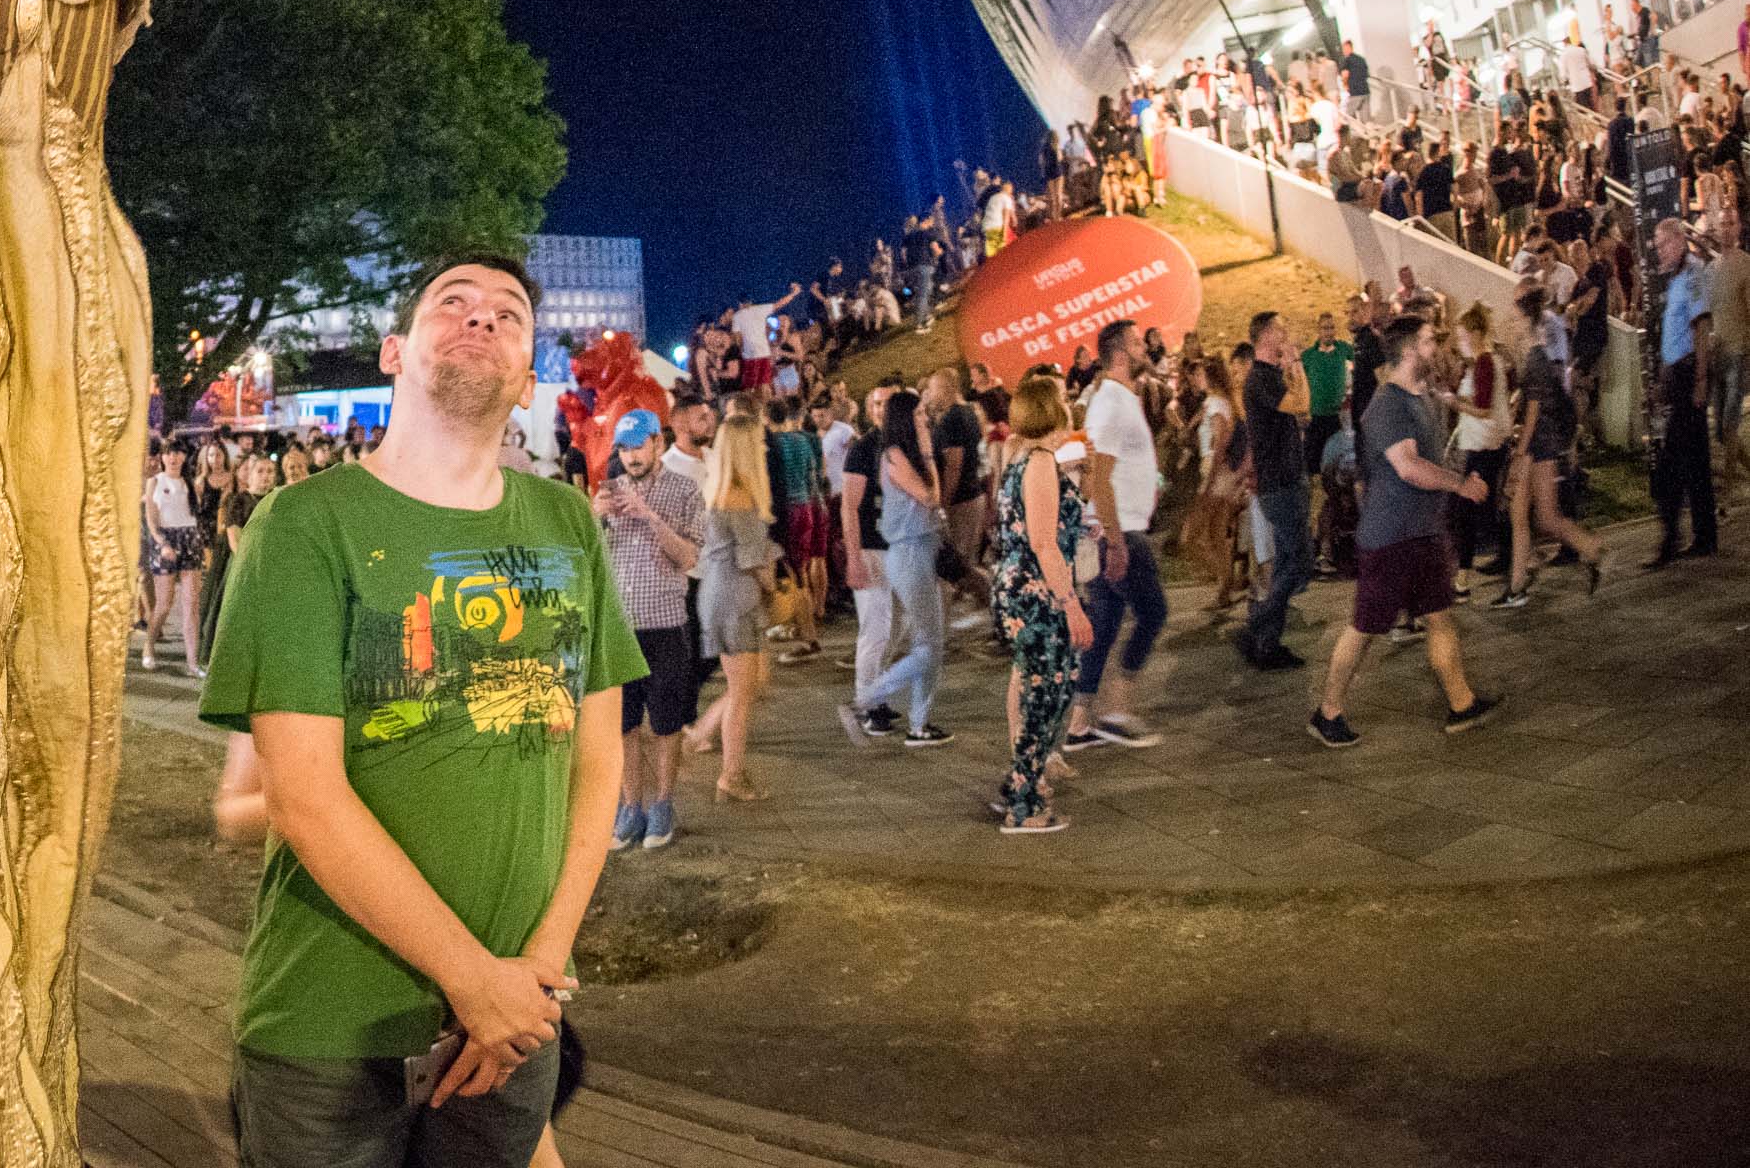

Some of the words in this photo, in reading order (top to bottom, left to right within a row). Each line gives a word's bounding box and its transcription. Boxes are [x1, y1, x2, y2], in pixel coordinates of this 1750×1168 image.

[1053, 259, 1170, 320] SUPERSTAR
[1023, 334, 1054, 358] DE
[1055, 294, 1153, 344] FESTIVAL
